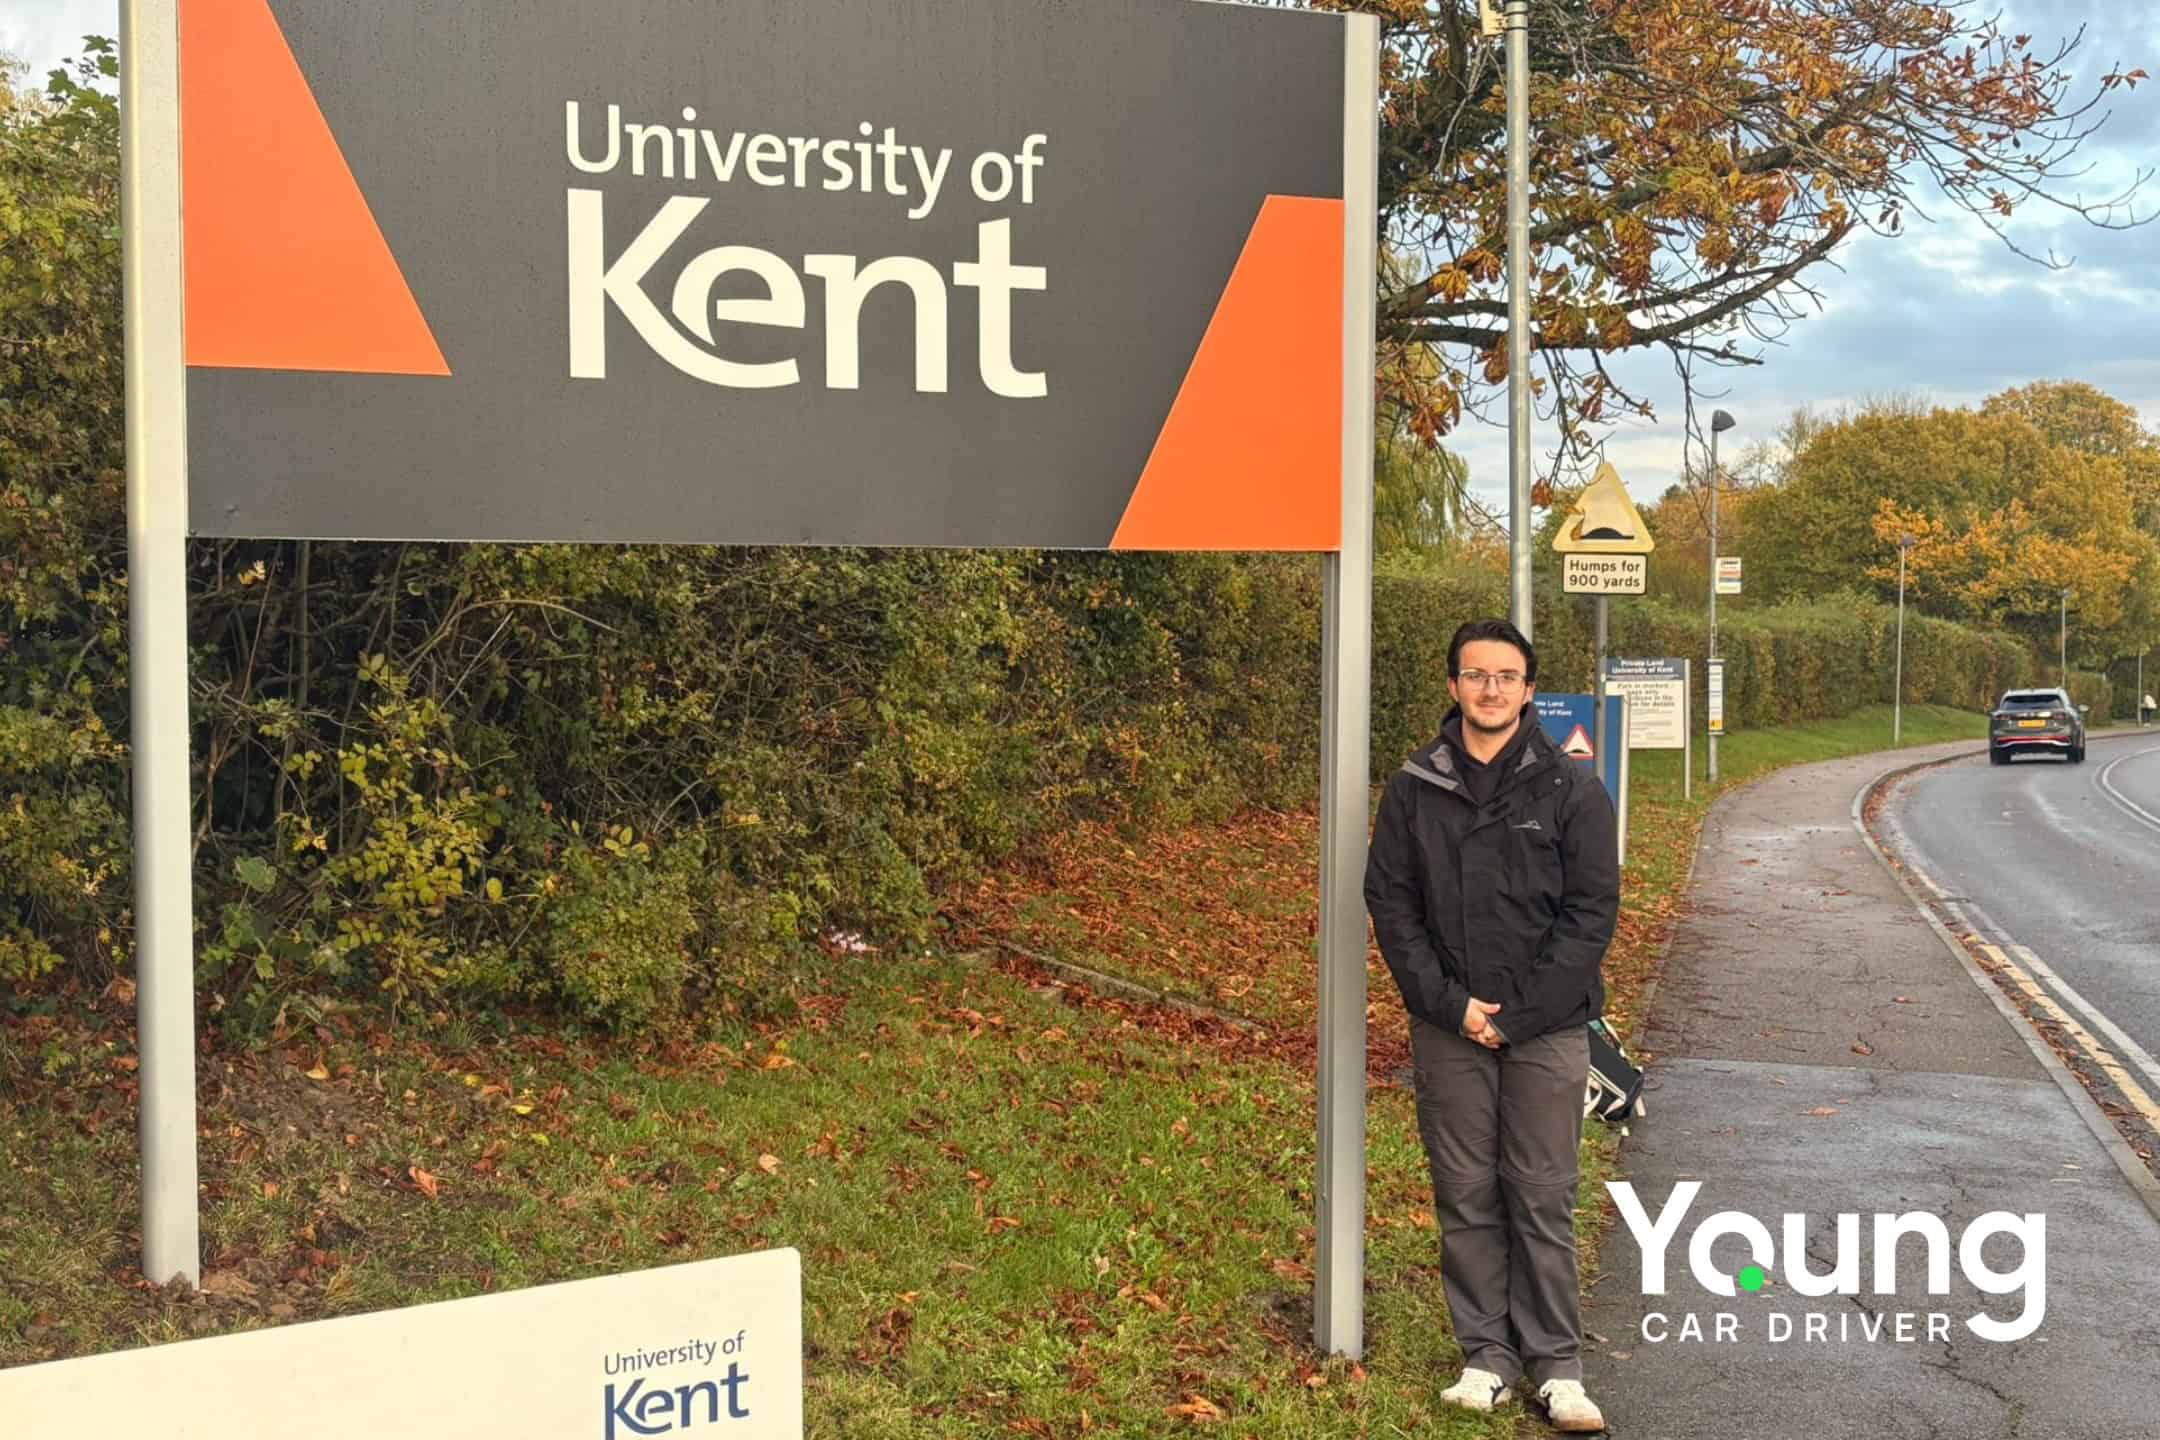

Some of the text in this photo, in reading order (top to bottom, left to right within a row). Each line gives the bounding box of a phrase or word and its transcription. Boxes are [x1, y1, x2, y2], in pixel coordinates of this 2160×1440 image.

[566, 100, 1048, 219] University of
[567, 188, 1048, 399] Kent
[1569, 560, 1641, 573] Humps for
[1569, 574, 1641, 589] 900 yards
[1611, 666, 1647, 674] University
[604, 1329, 746, 1375] University of
[604, 1361, 750, 1440] Kent
